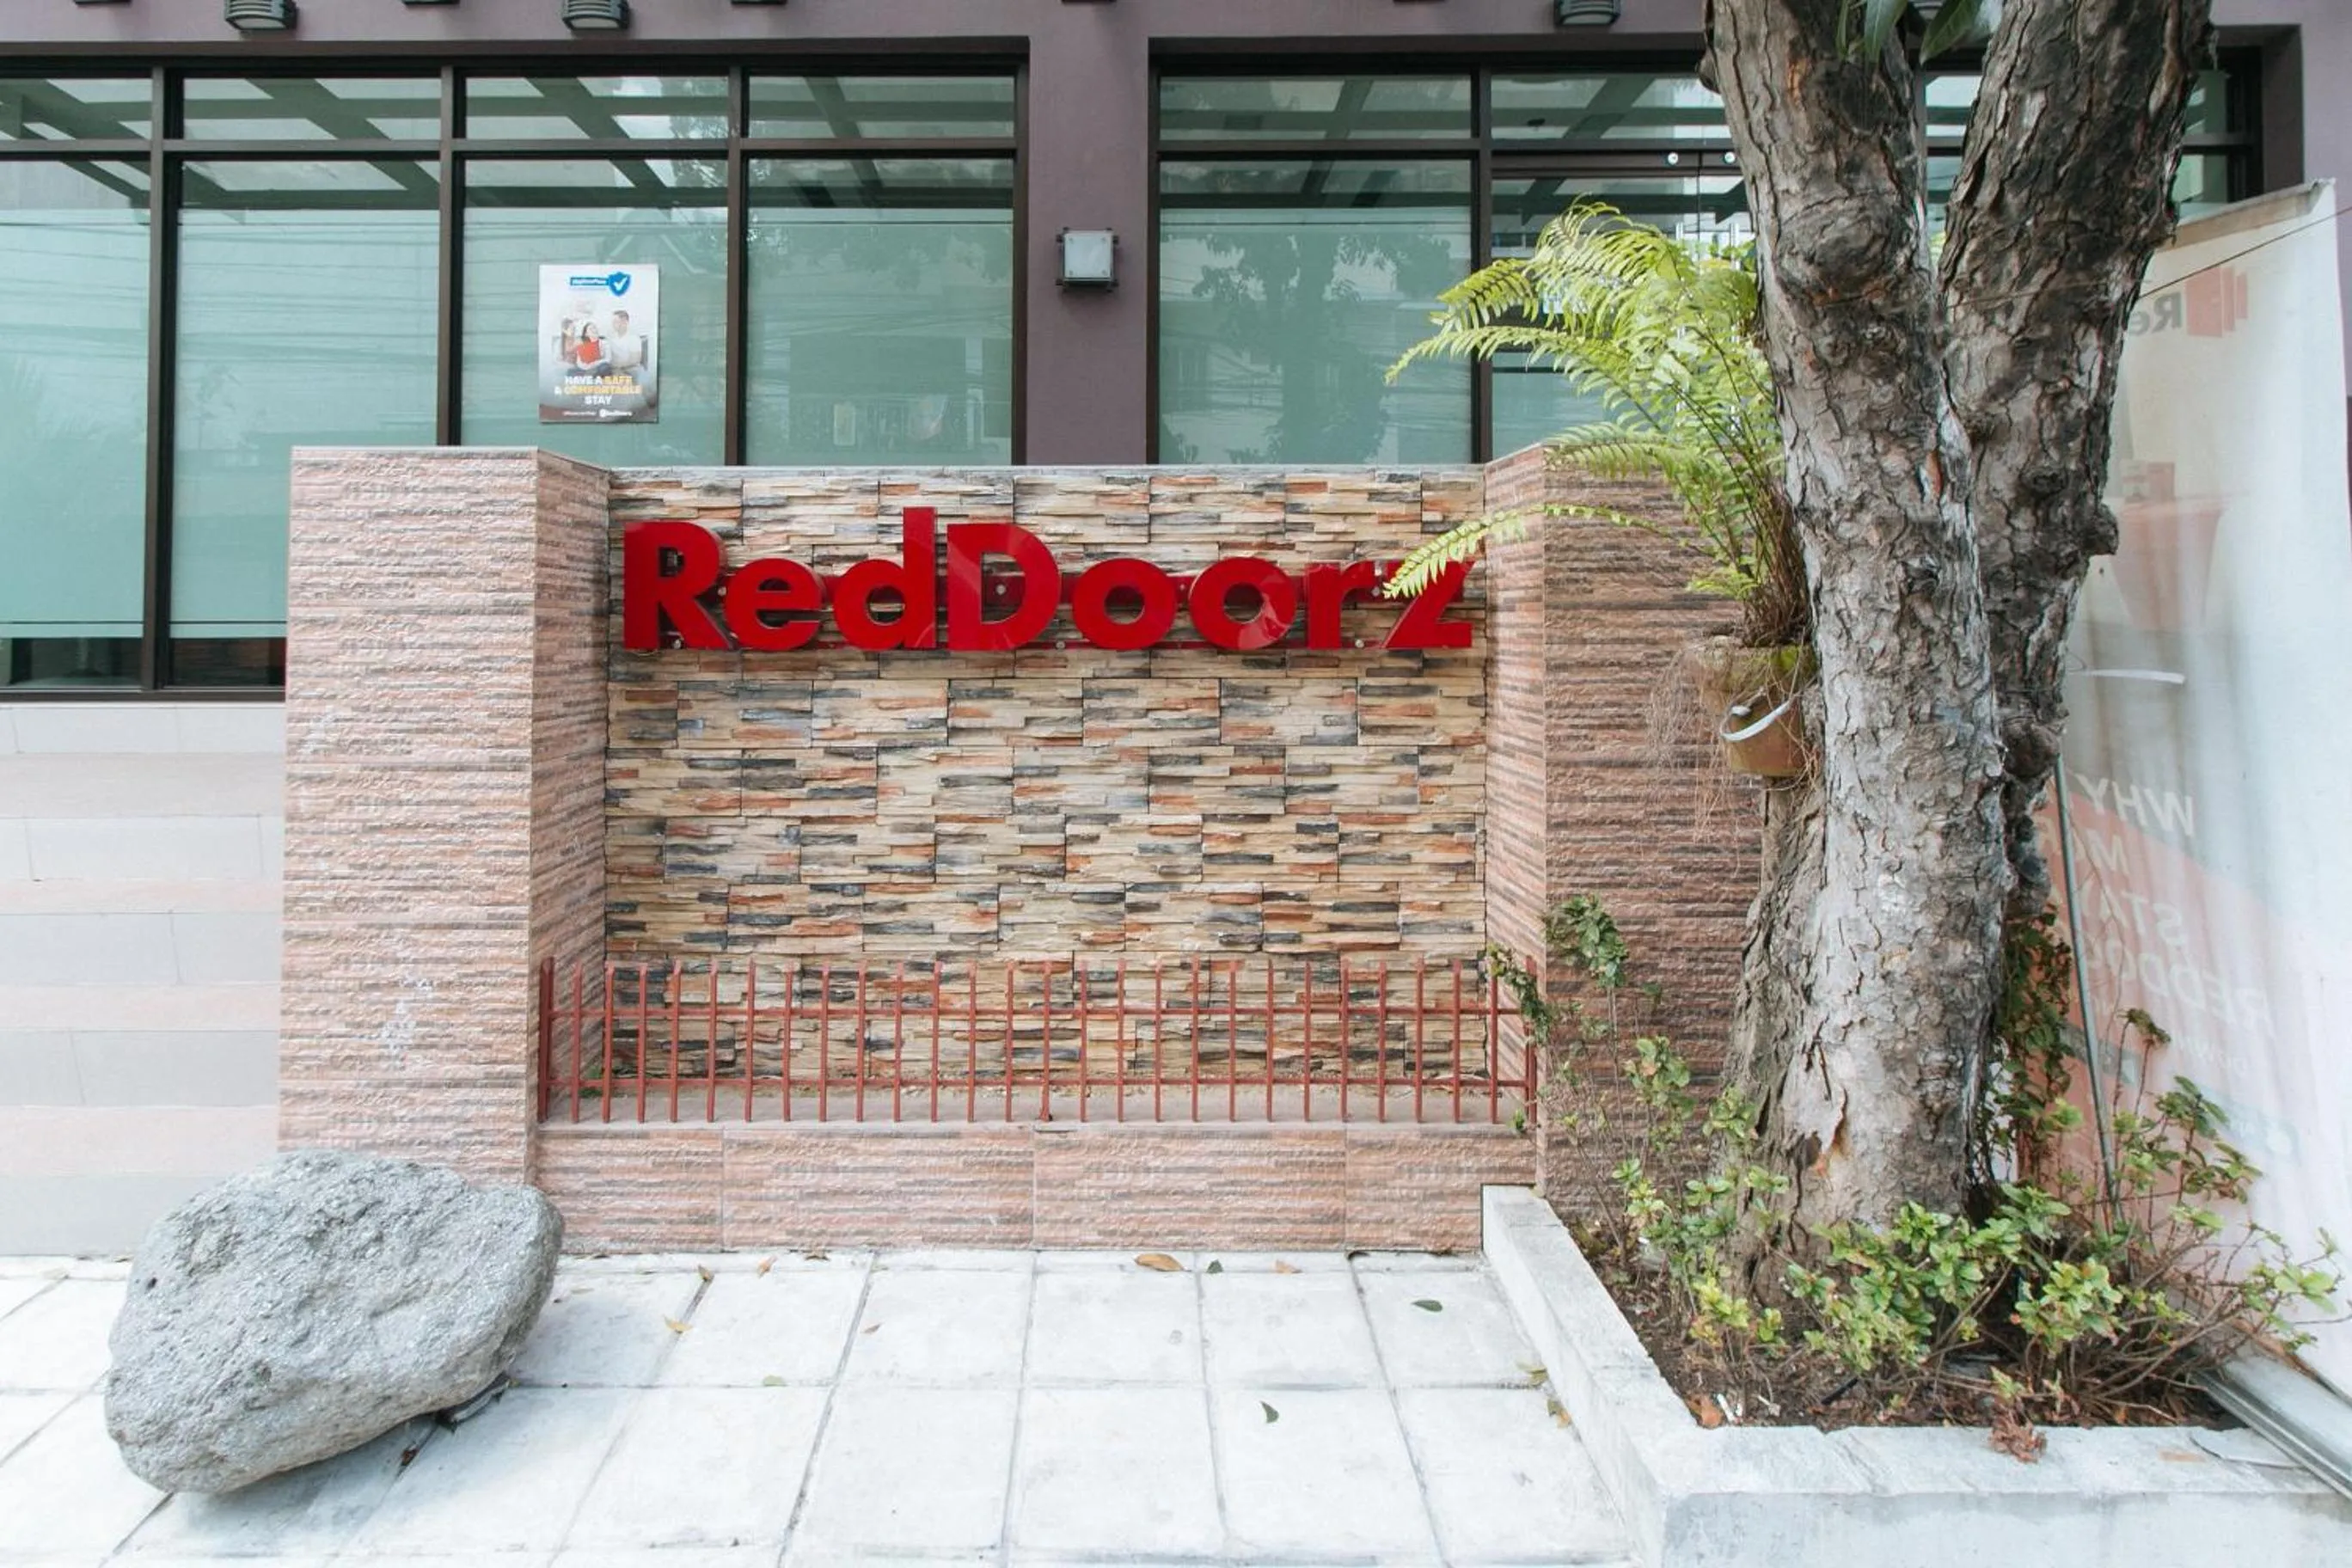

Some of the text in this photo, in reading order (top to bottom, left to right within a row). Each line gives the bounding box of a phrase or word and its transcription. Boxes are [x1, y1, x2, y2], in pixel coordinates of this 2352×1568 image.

[564, 376, 593, 385] HAVE
[595, 376, 603, 385] A
[585, 395, 612, 405] STAY
[623, 506, 1476, 651] RedDoorz
